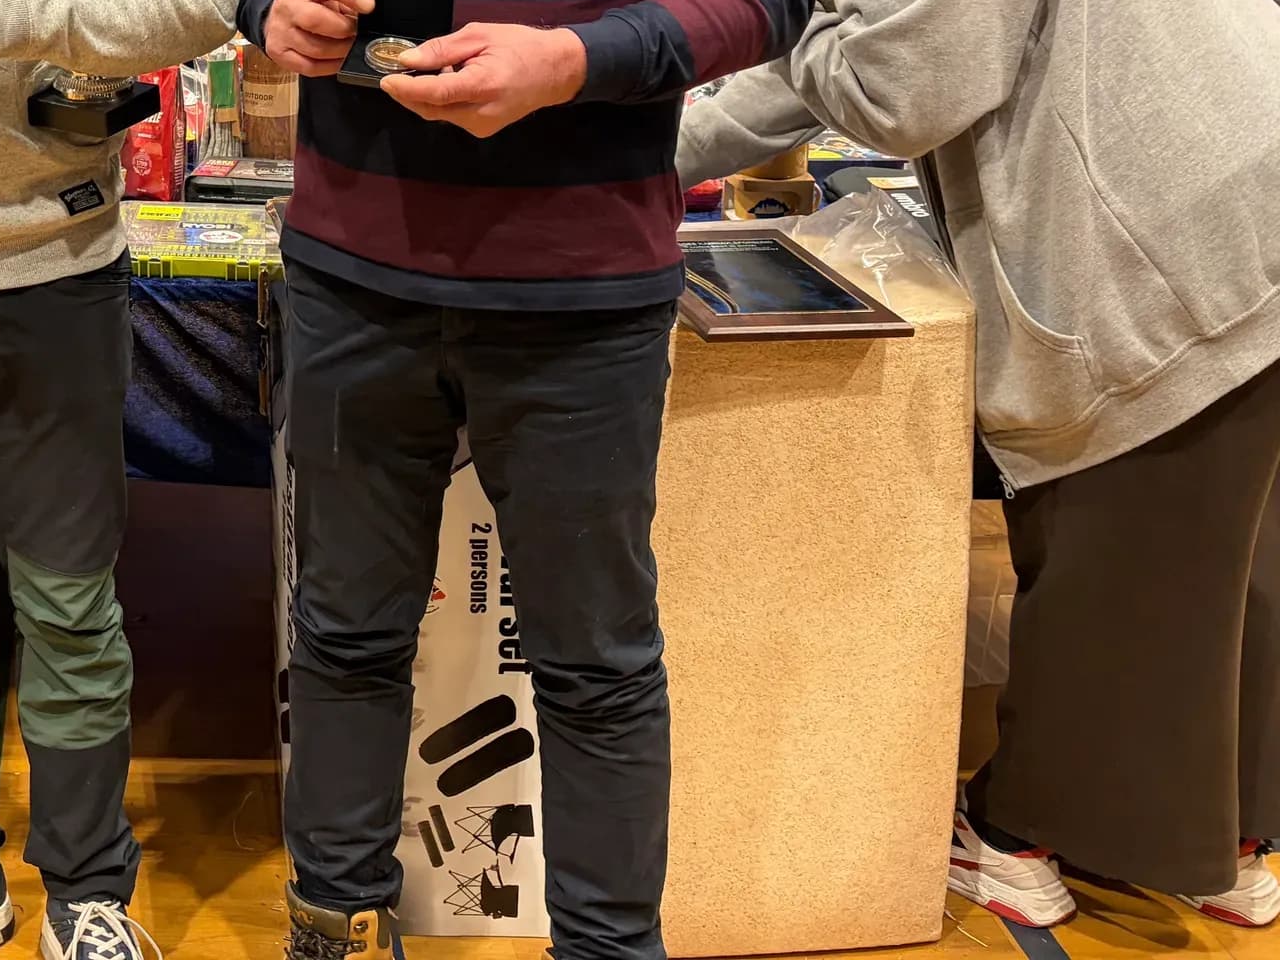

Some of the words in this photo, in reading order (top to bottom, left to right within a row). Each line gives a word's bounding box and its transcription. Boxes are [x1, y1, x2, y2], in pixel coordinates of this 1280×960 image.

[890, 192, 931, 218] umbro
[471, 523, 492, 534] 2
[469, 539, 489, 614] persons
